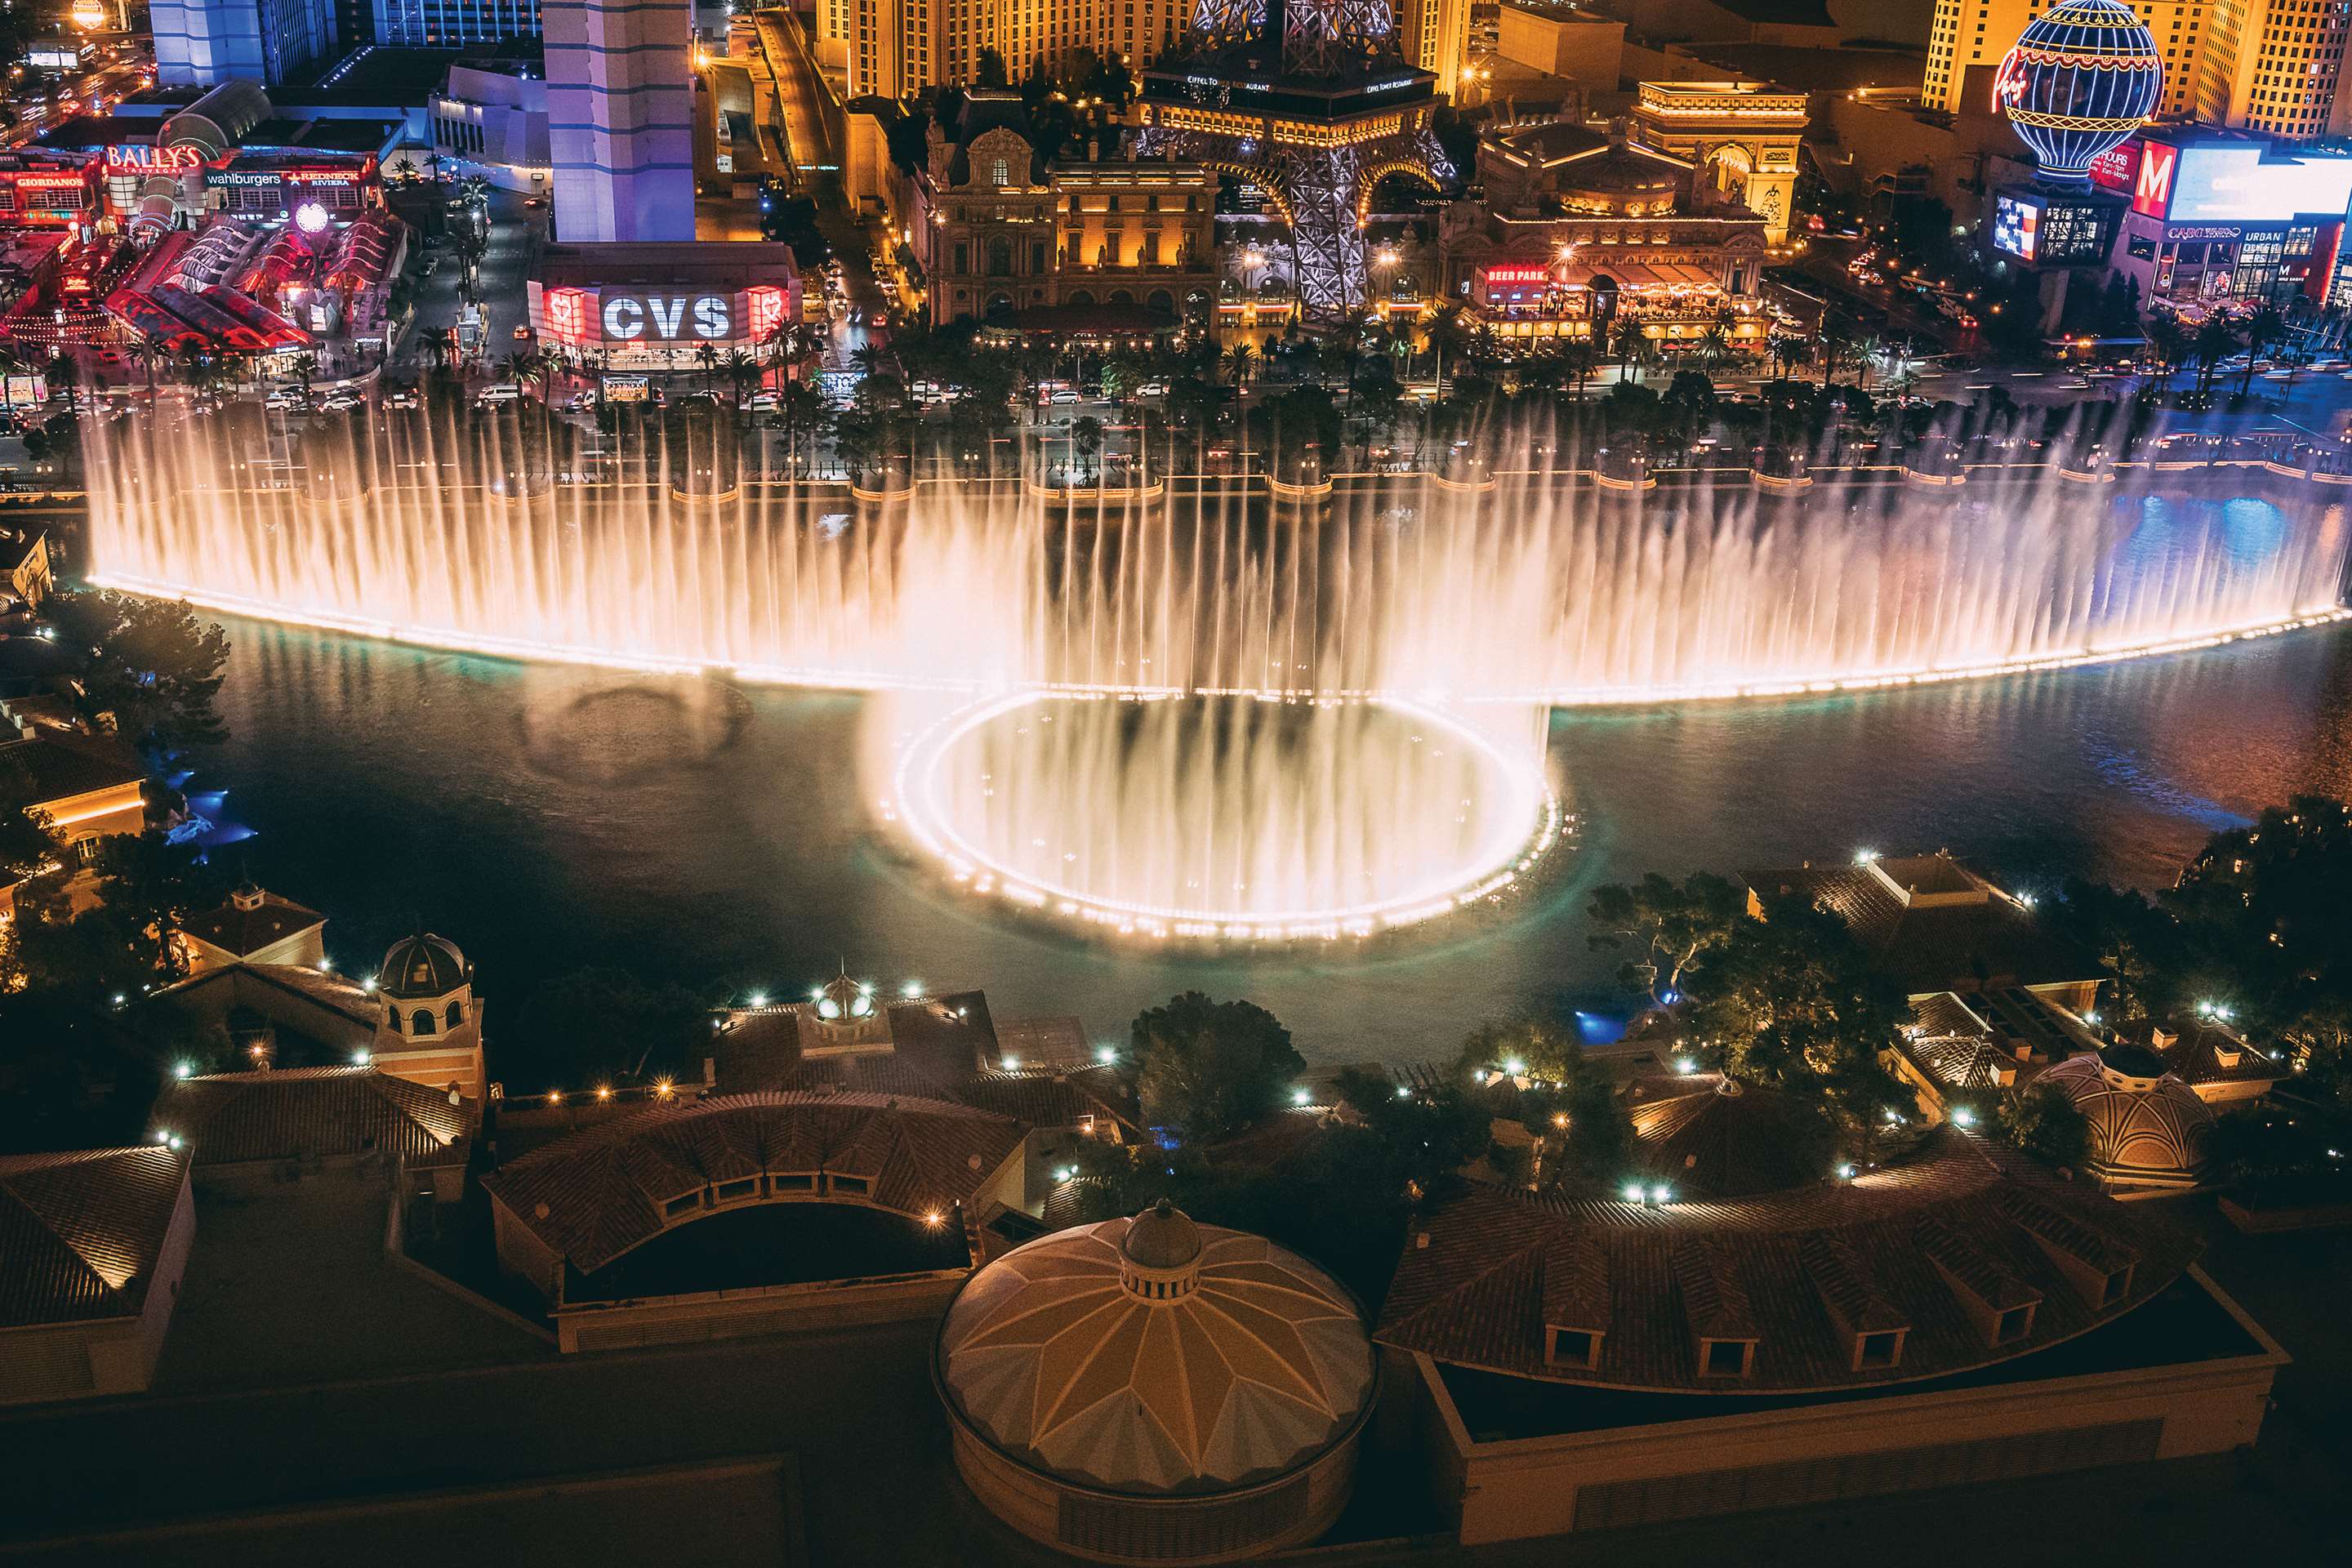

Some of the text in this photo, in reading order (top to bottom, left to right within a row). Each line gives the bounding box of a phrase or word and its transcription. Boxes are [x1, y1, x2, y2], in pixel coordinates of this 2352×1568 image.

[1187, 76, 1208, 85] EIFFEL
[108, 146, 200, 168] BALLY'S
[207, 173, 281, 186] wahlburgers
[300, 172, 359, 180] REDNECK
[2138, 149, 2173, 203] M
[17, 177, 84, 187] GIORDANO'S
[2245, 232, 2281, 242] URBAN
[2278, 265, 2291, 276] M
[1489, 271, 1544, 281] BEER PARK
[604, 297, 729, 339] CVS
